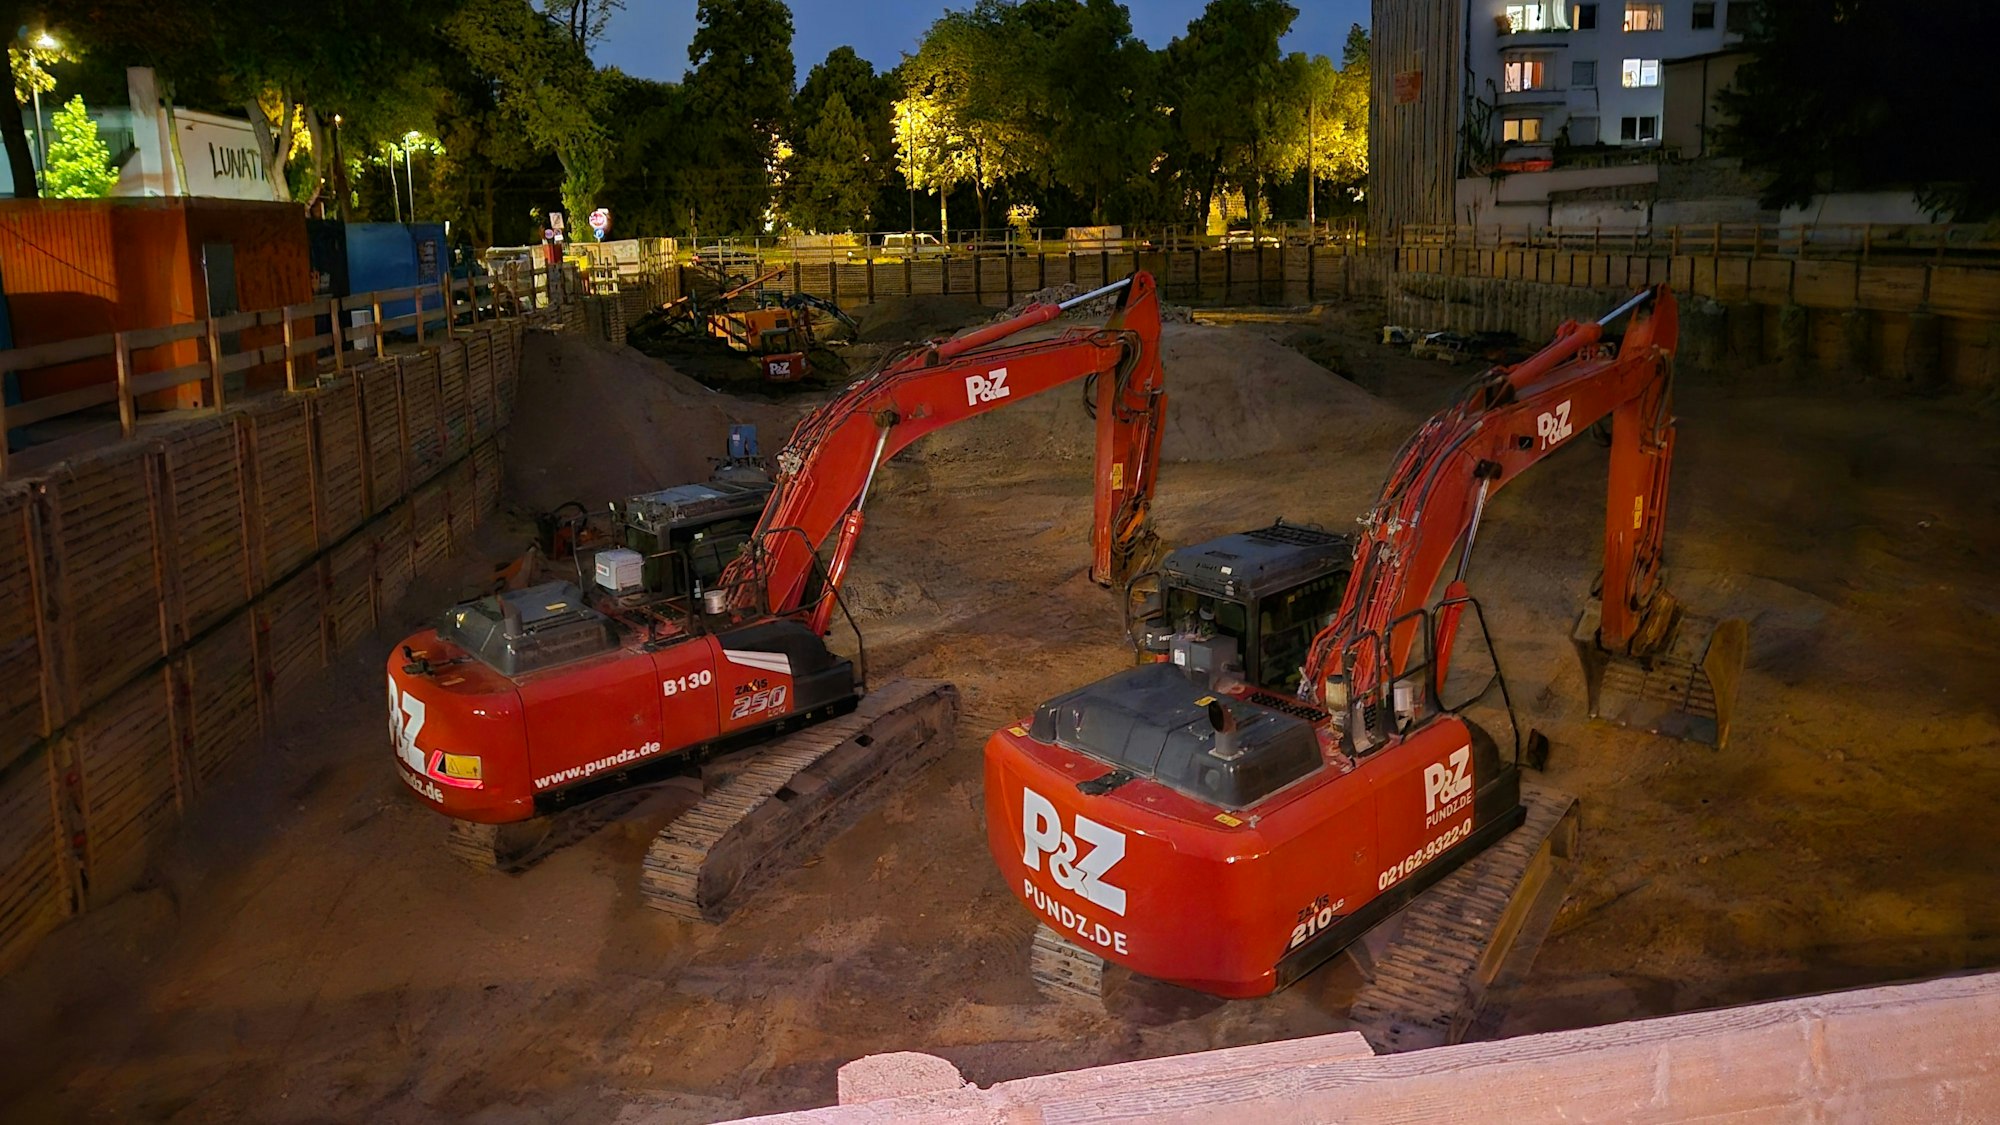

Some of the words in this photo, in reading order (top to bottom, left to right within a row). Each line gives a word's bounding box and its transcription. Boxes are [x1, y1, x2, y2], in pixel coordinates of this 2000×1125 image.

[769, 361, 790, 376] P&Z
[965, 367, 1010, 407] P&Z
[1537, 399, 1573, 451] P&Z
[663, 669, 712, 697] B130
[730, 685, 787, 720] 250
[534, 740, 661, 789] www.pundz.de
[1423, 744, 1472, 814] P&Z
[1425, 790, 1473, 830] PUNDZ.DE
[1023, 786, 1127, 917] P&Z
[1378, 817, 1472, 891] 02162-9322-0
[1023, 878, 1129, 956] PUNDZ.DE
[1291, 907, 1332, 949] 210
[1332, 898, 1345, 912] LC
